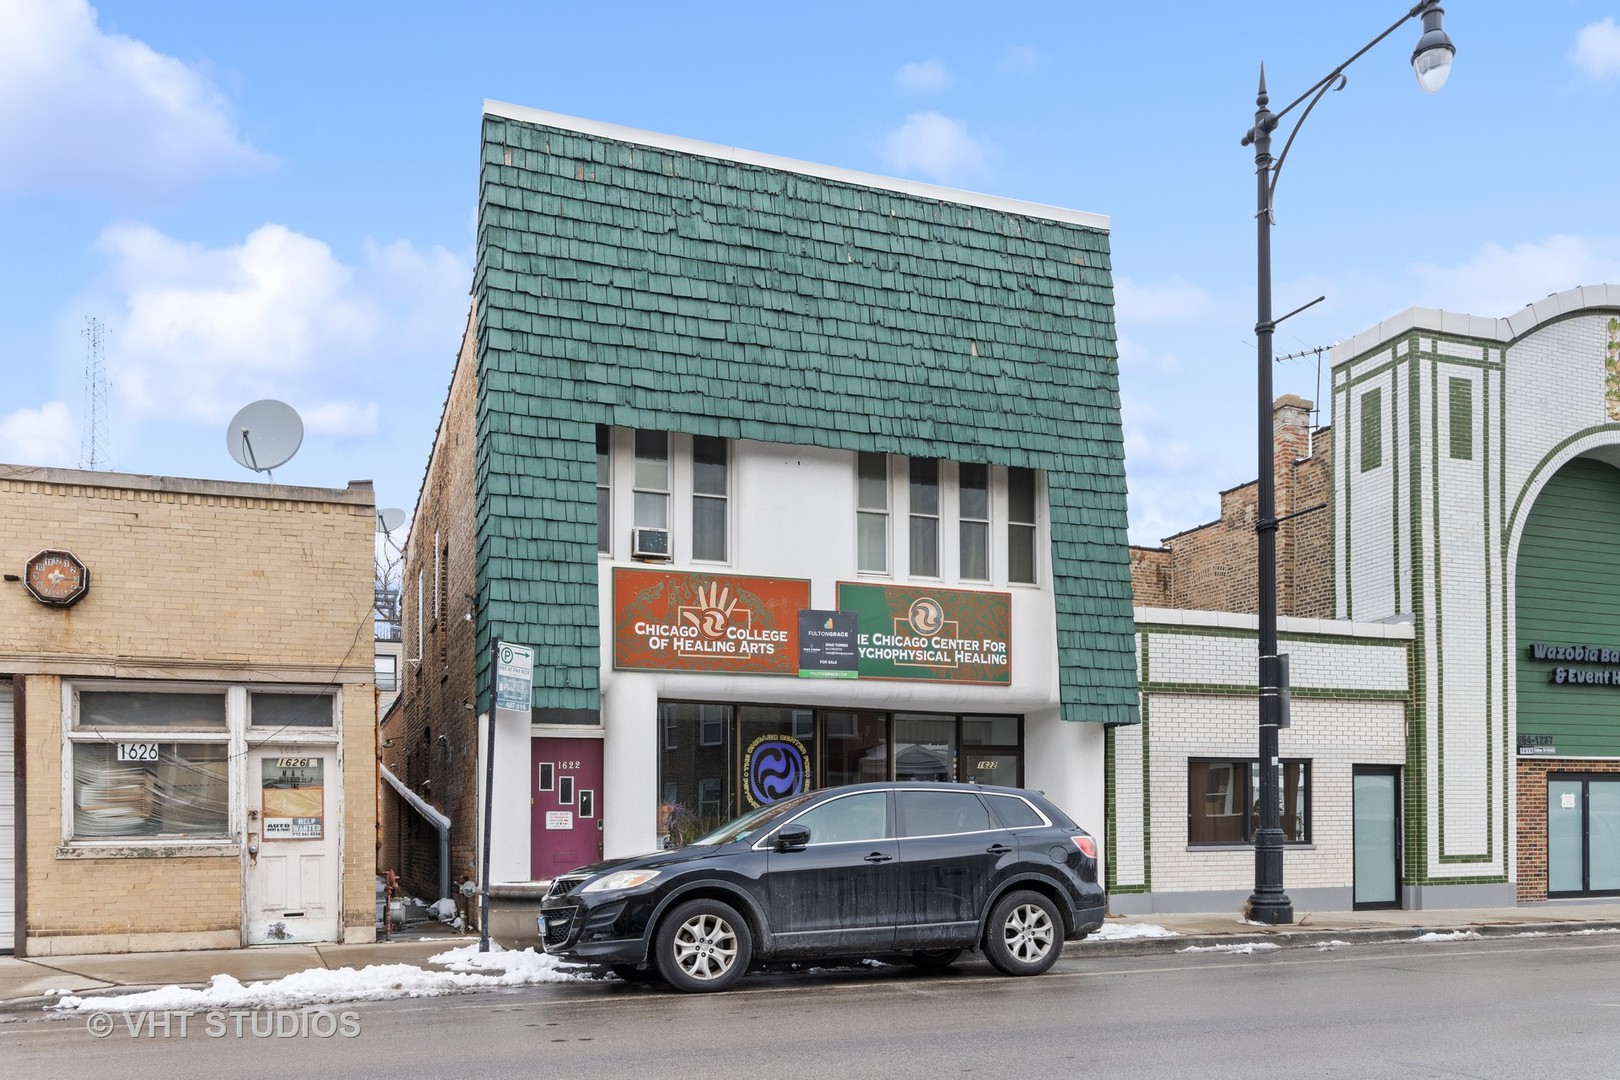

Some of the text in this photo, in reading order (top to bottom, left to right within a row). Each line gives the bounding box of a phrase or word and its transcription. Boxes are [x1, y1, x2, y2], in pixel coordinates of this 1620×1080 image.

[635, 622, 788, 641] CHICAGO COLLEGE
[649, 637, 775, 654] OF HEALING ARTS
[873, 633, 927, 648] CHICAGO
[931, 638, 979, 650] CENTER
[983, 640, 1006, 652] FOR
[955, 651, 1007, 664] HEALING
[1534, 644, 1599, 662] Wazobia
[1556, 667, 1567, 683] &
[1568, 668, 1610, 684] Event
[120, 744, 157, 759] 1626
[558, 761, 580, 769] 1622
